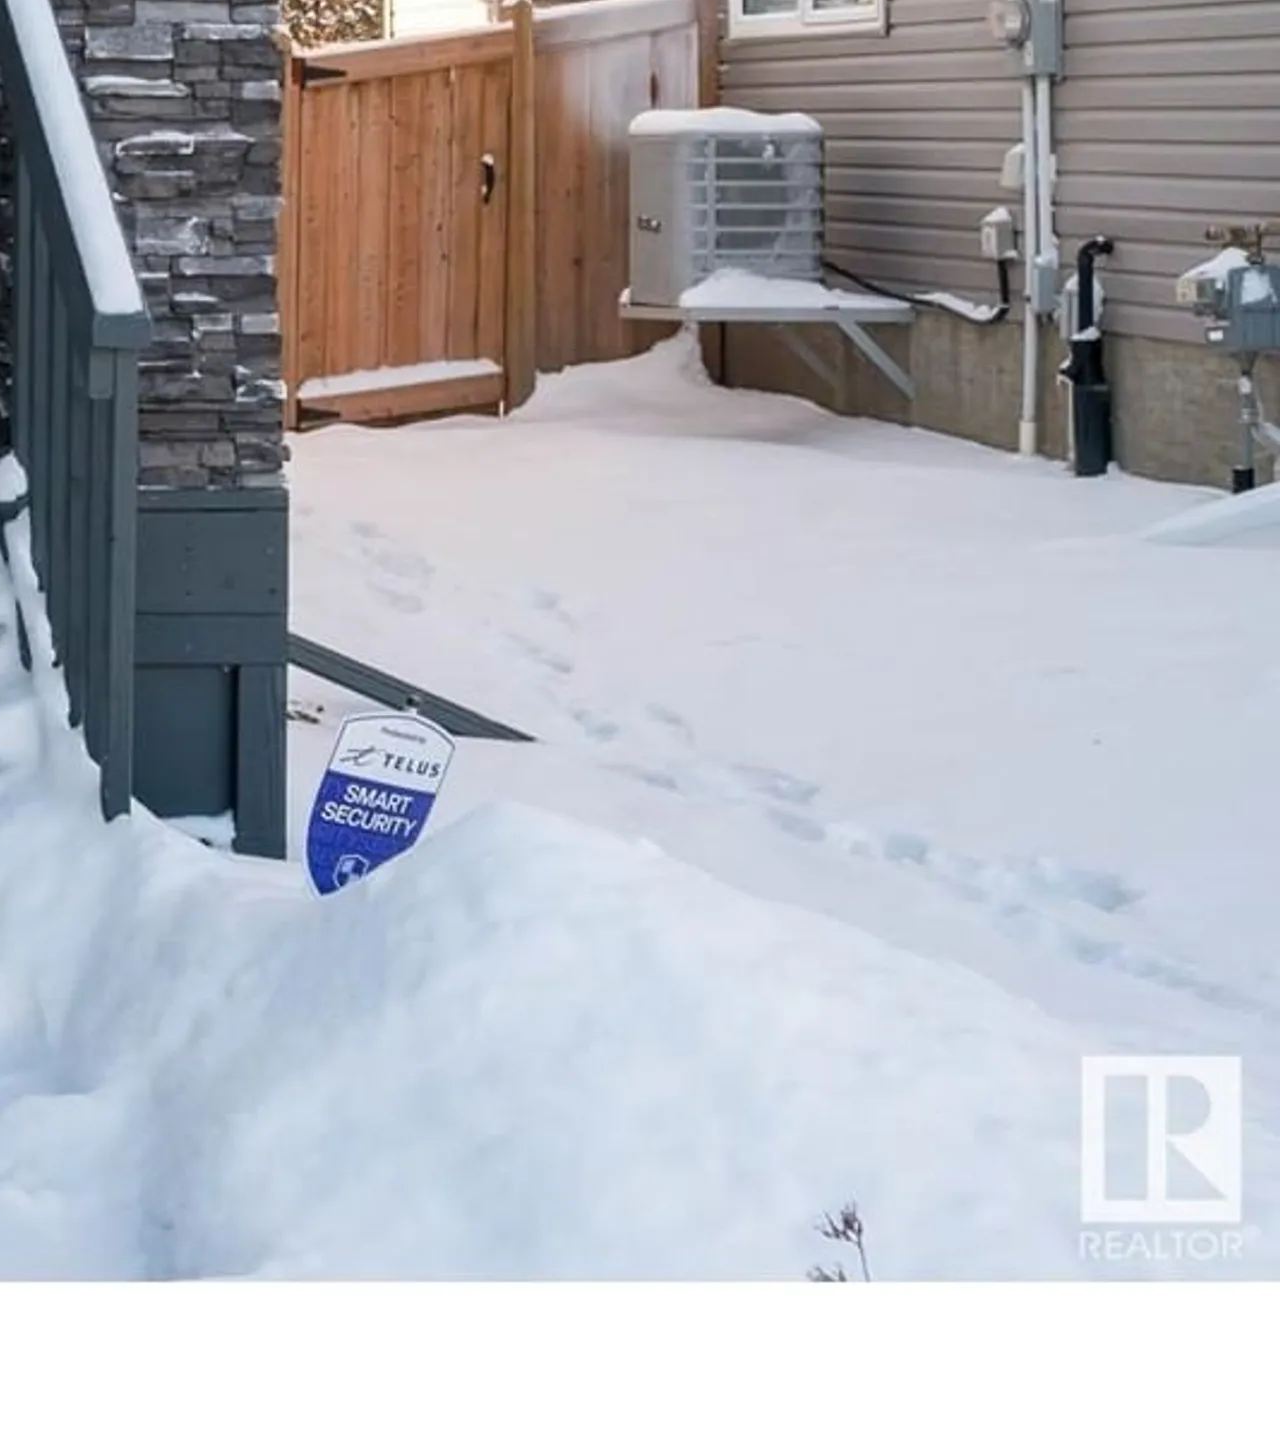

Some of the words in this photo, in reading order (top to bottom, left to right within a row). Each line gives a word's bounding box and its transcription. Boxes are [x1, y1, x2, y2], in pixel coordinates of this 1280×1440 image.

[383, 753, 440, 778] TELUS
[344, 784, 414, 814] SMART
[321, 801, 416, 837] SECURITY
